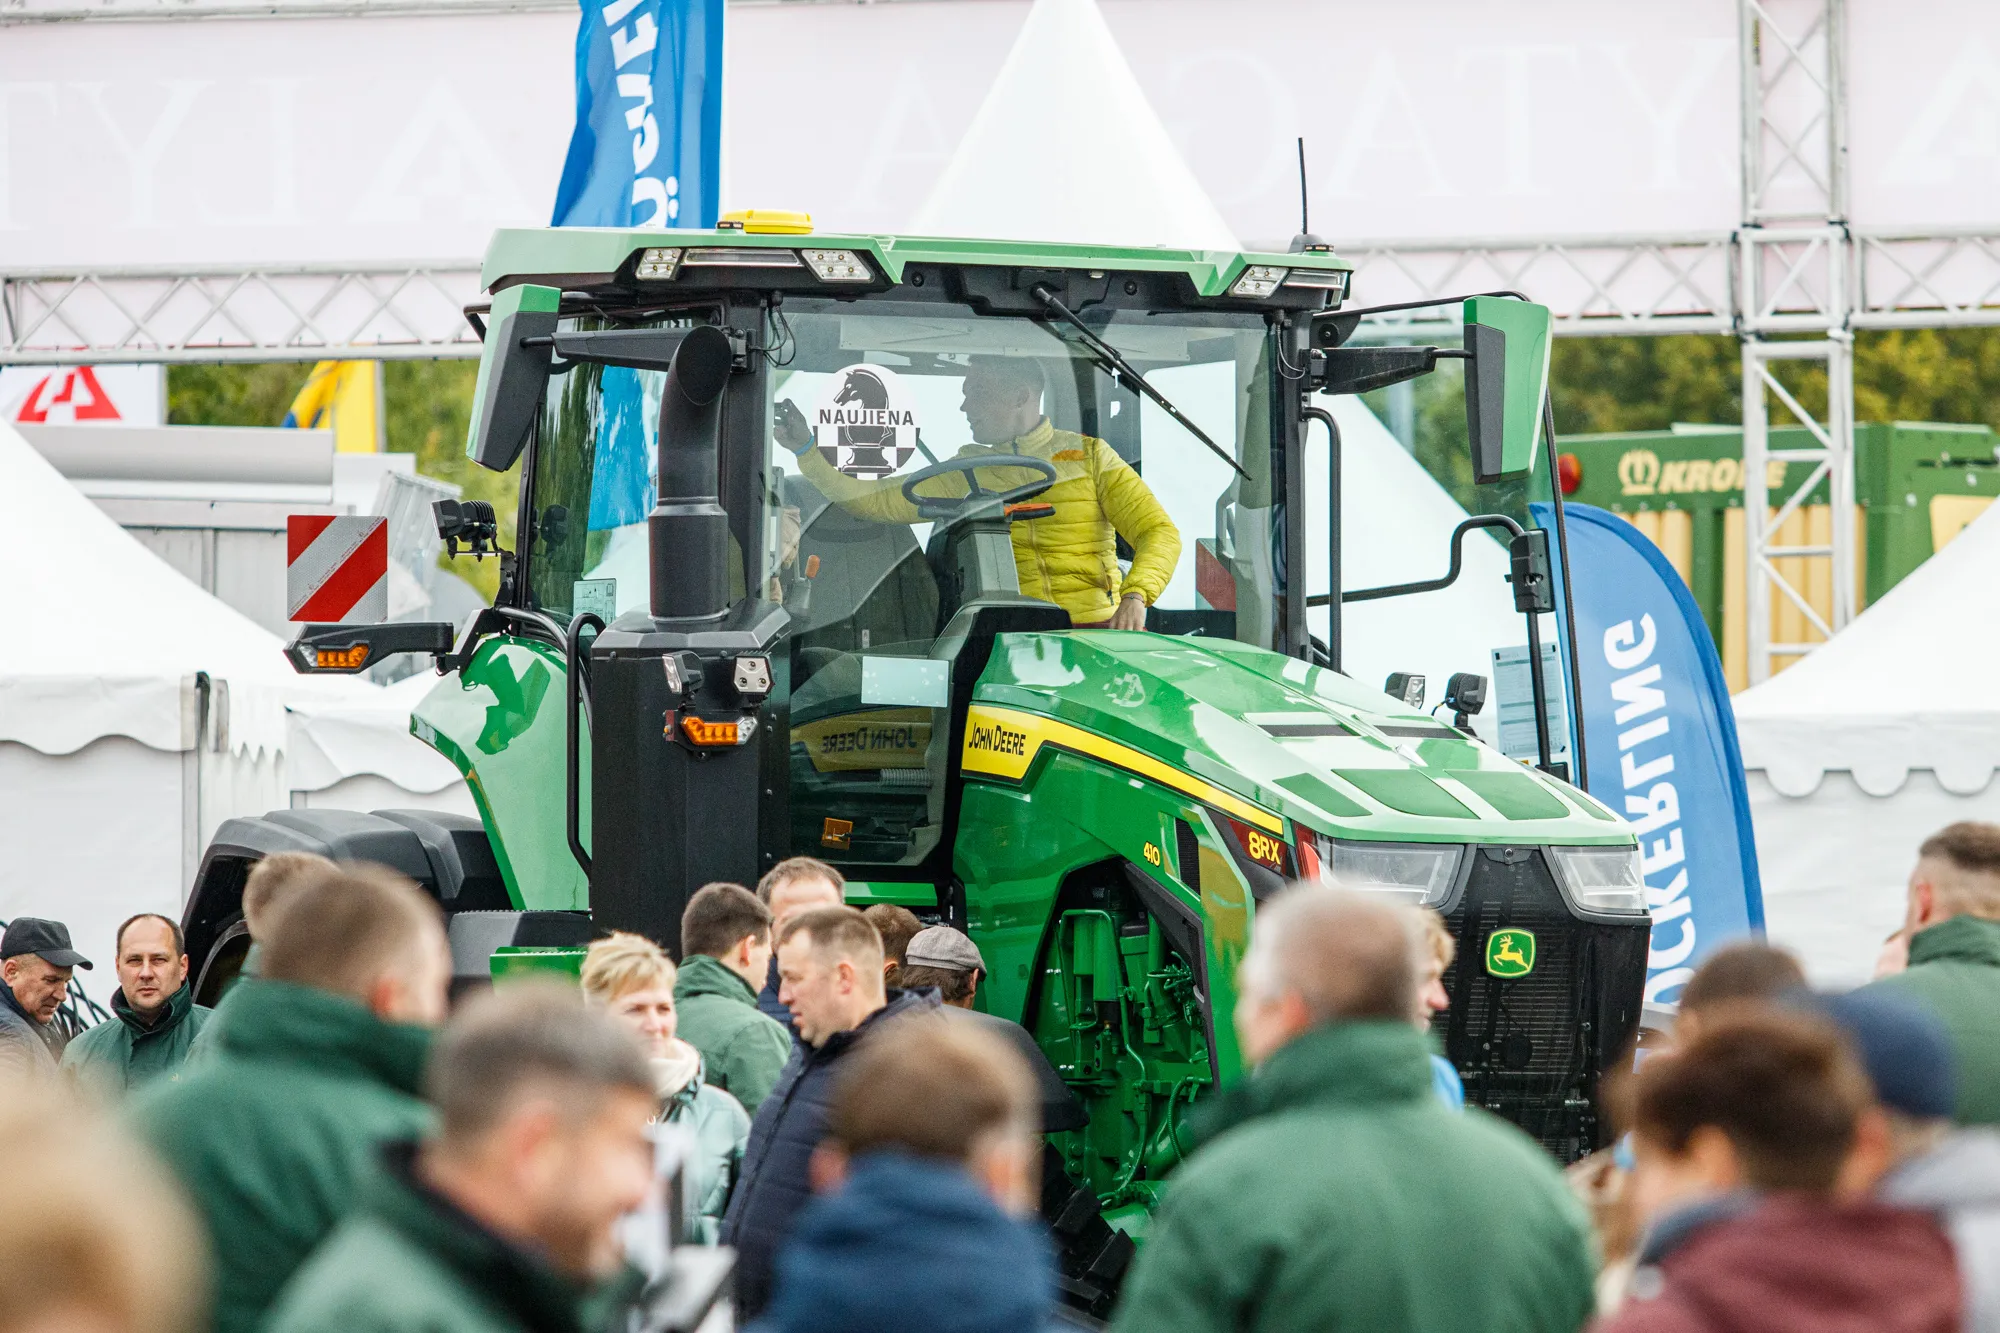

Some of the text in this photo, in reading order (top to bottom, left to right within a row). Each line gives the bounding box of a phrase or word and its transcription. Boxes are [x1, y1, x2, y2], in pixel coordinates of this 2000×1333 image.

[819, 408, 914, 426] NAUJIENA
[1658, 458, 1788, 494] KROE
[1143, 841, 1161, 867] 410
[1248, 831, 1281, 865] 8RX
